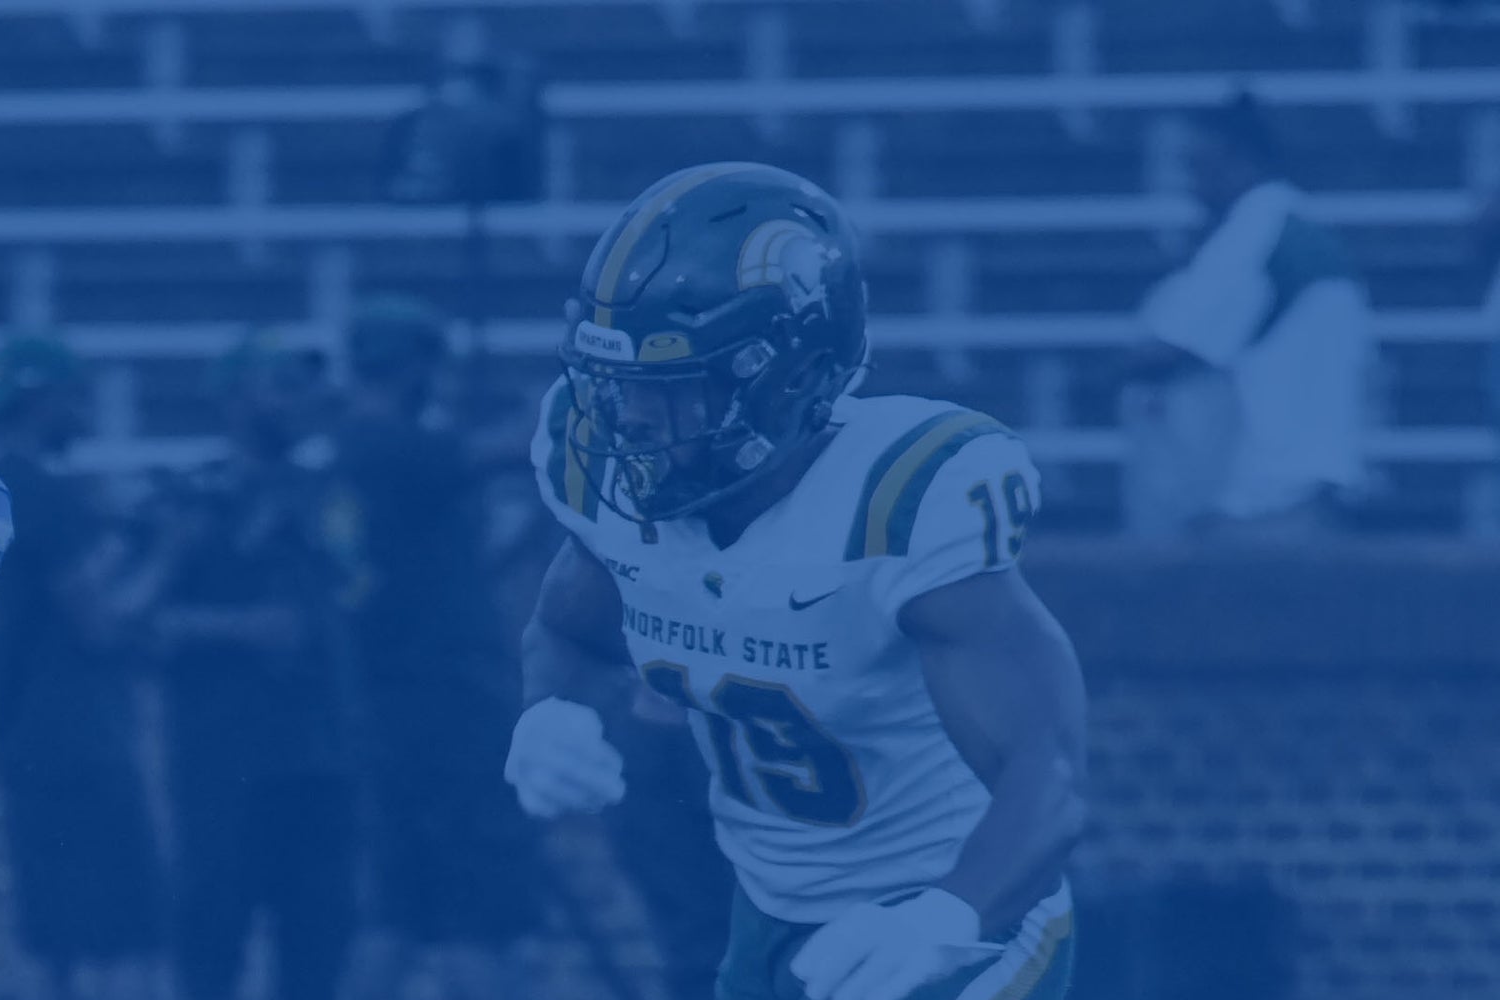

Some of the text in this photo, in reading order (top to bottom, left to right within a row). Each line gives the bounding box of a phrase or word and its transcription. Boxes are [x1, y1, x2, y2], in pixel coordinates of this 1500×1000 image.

[966, 471, 1031, 568] 19
[622, 603, 830, 670] NORFOLK STATE
[641, 659, 868, 829] 19
